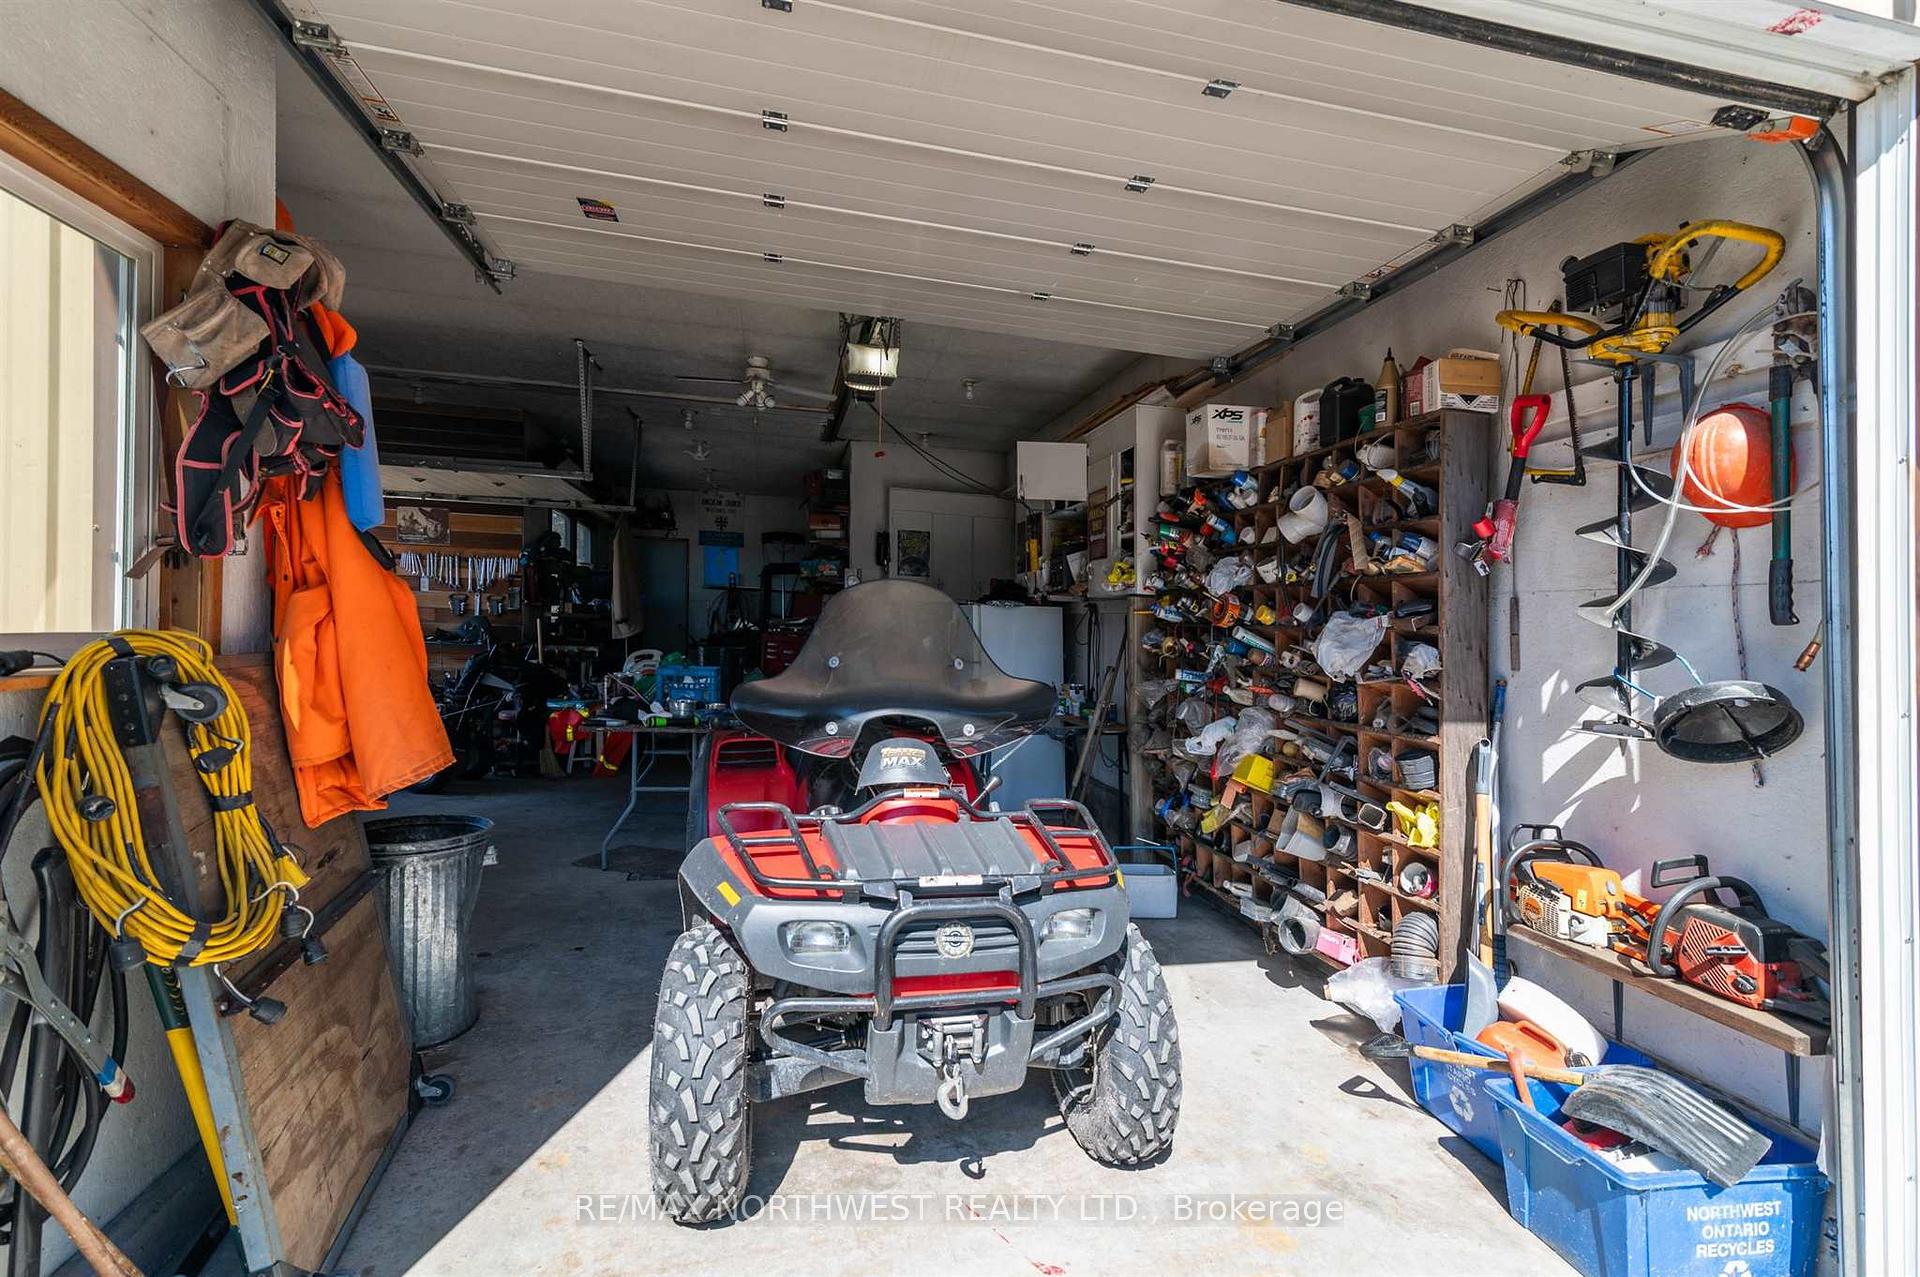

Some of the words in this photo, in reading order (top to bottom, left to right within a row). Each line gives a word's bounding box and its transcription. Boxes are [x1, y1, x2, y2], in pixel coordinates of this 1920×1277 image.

[1211, 407, 1244, 420] XPS
[883, 756, 924, 768] MAX
[1686, 1201, 1781, 1221] NORTHWEST
[1702, 1221, 1769, 1239] ONTARIO
[1696, 1239, 1775, 1258] RECYCLES
